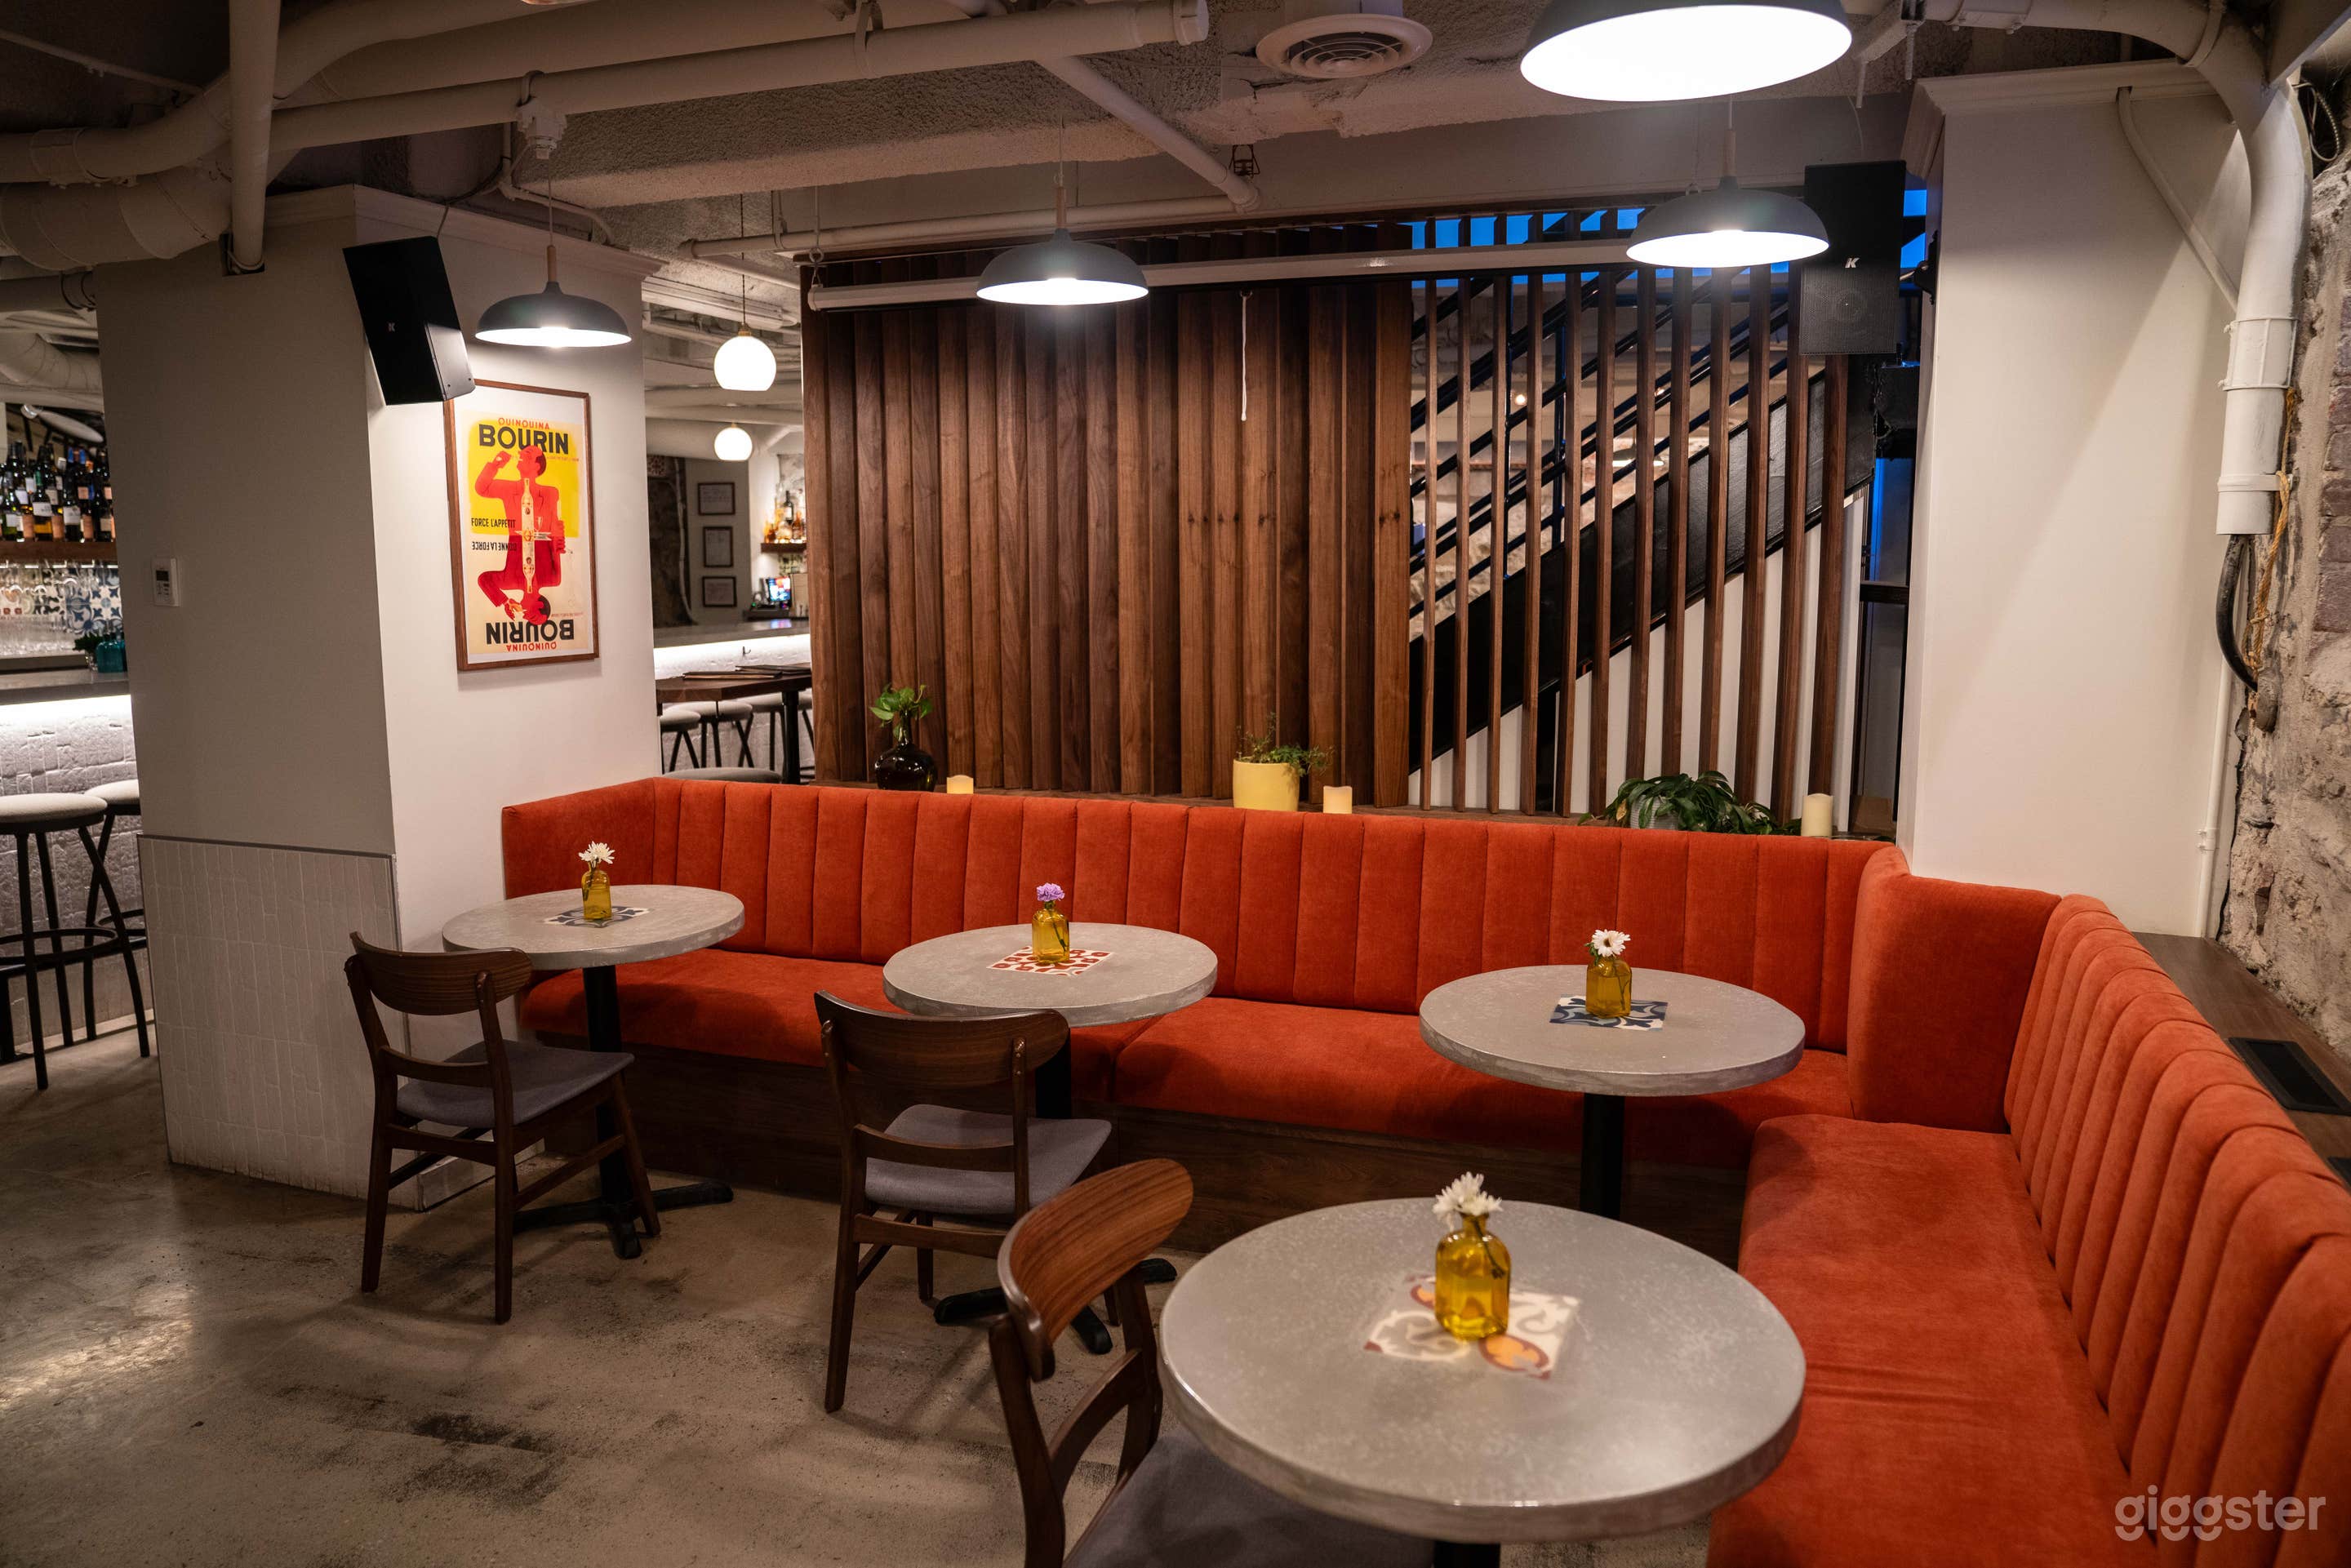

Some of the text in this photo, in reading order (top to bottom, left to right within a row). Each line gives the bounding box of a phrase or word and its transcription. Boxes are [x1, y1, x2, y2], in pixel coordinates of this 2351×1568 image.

[498, 417, 550, 430] QUINQUINA
[478, 424, 569, 455] BOURIN
[471, 517, 490, 527] FORCE
[472, 541, 490, 550] FORCE
[491, 542, 497, 550] LA
[486, 620, 574, 645] BOURIN
[506, 642, 557, 651] QUINQUINA
